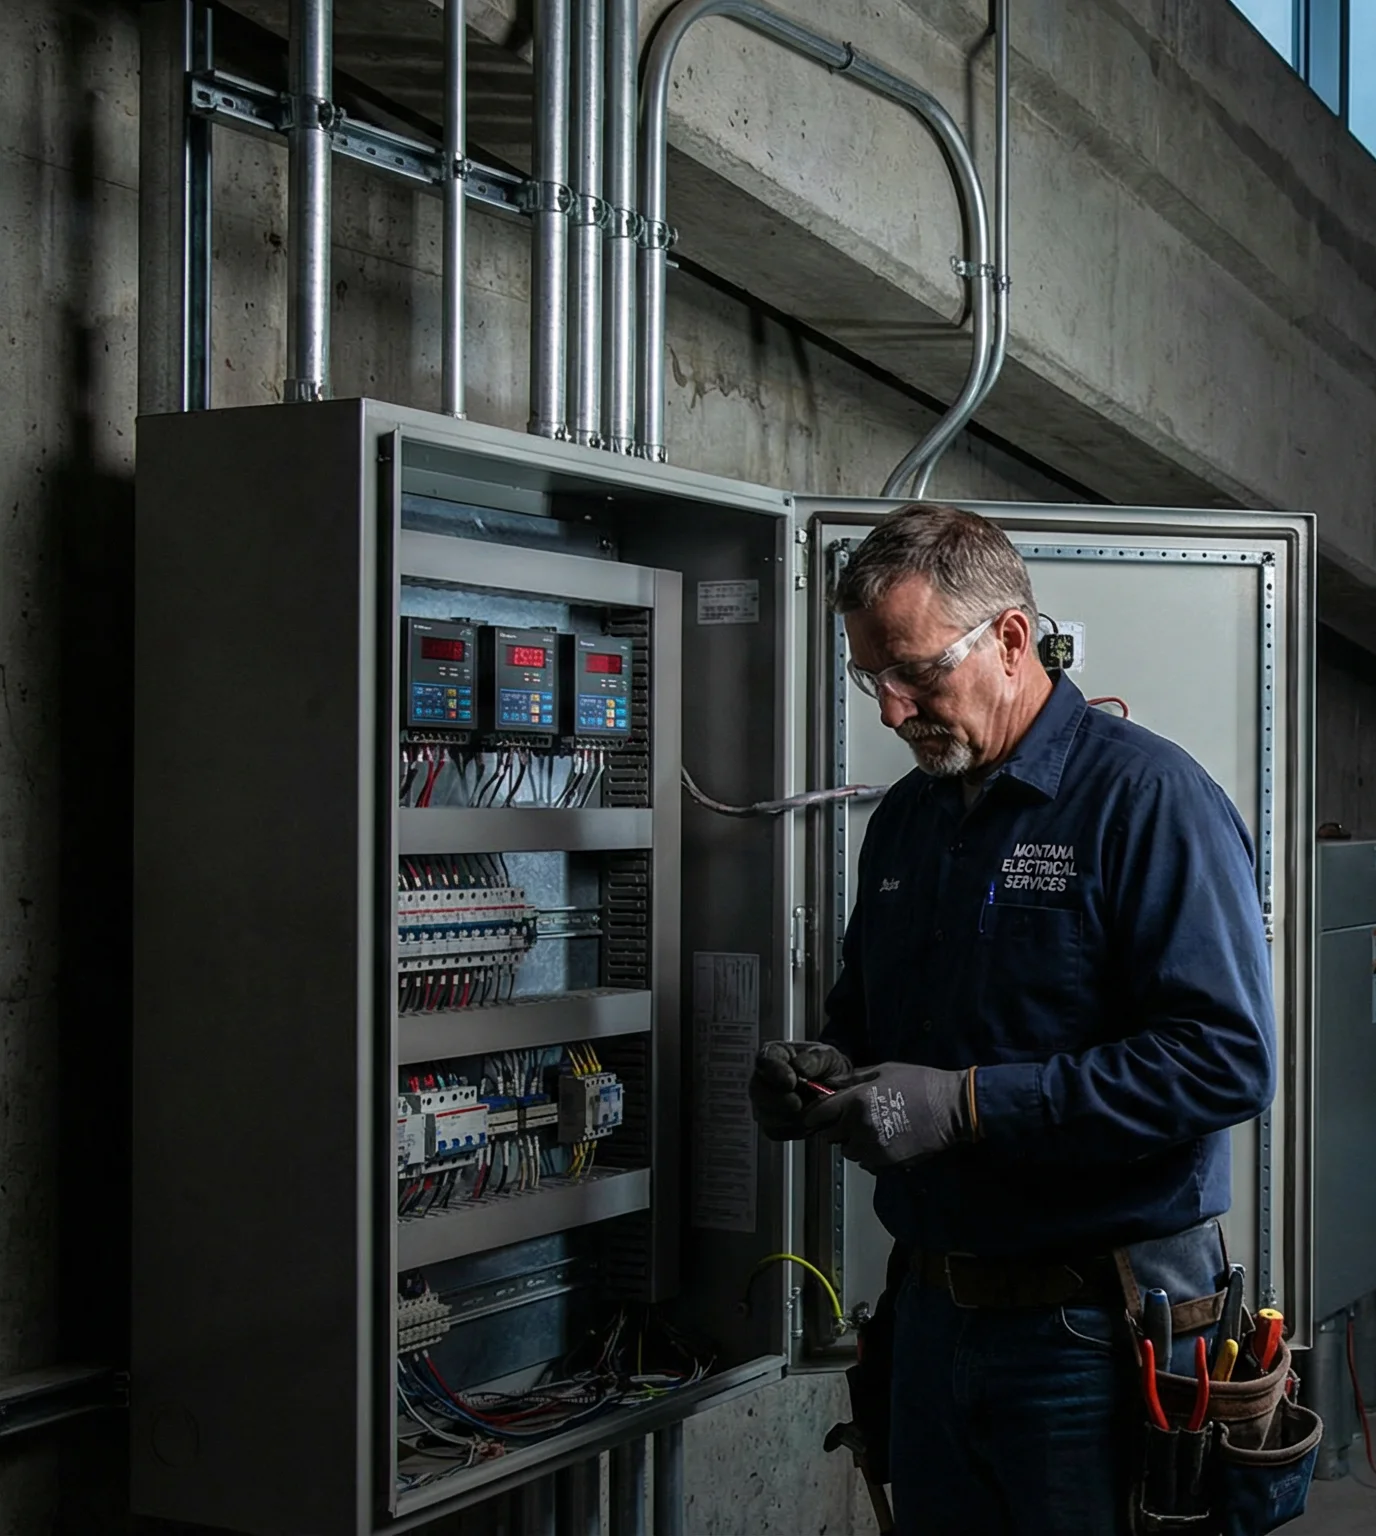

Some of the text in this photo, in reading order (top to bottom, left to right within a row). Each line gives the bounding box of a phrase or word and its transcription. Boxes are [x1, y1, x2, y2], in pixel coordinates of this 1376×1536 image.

[1013, 843, 1074, 860] MONTANA
[1001, 858, 1078, 877] ELECTRICAL
[1004, 874, 1067, 892] SERVICES
